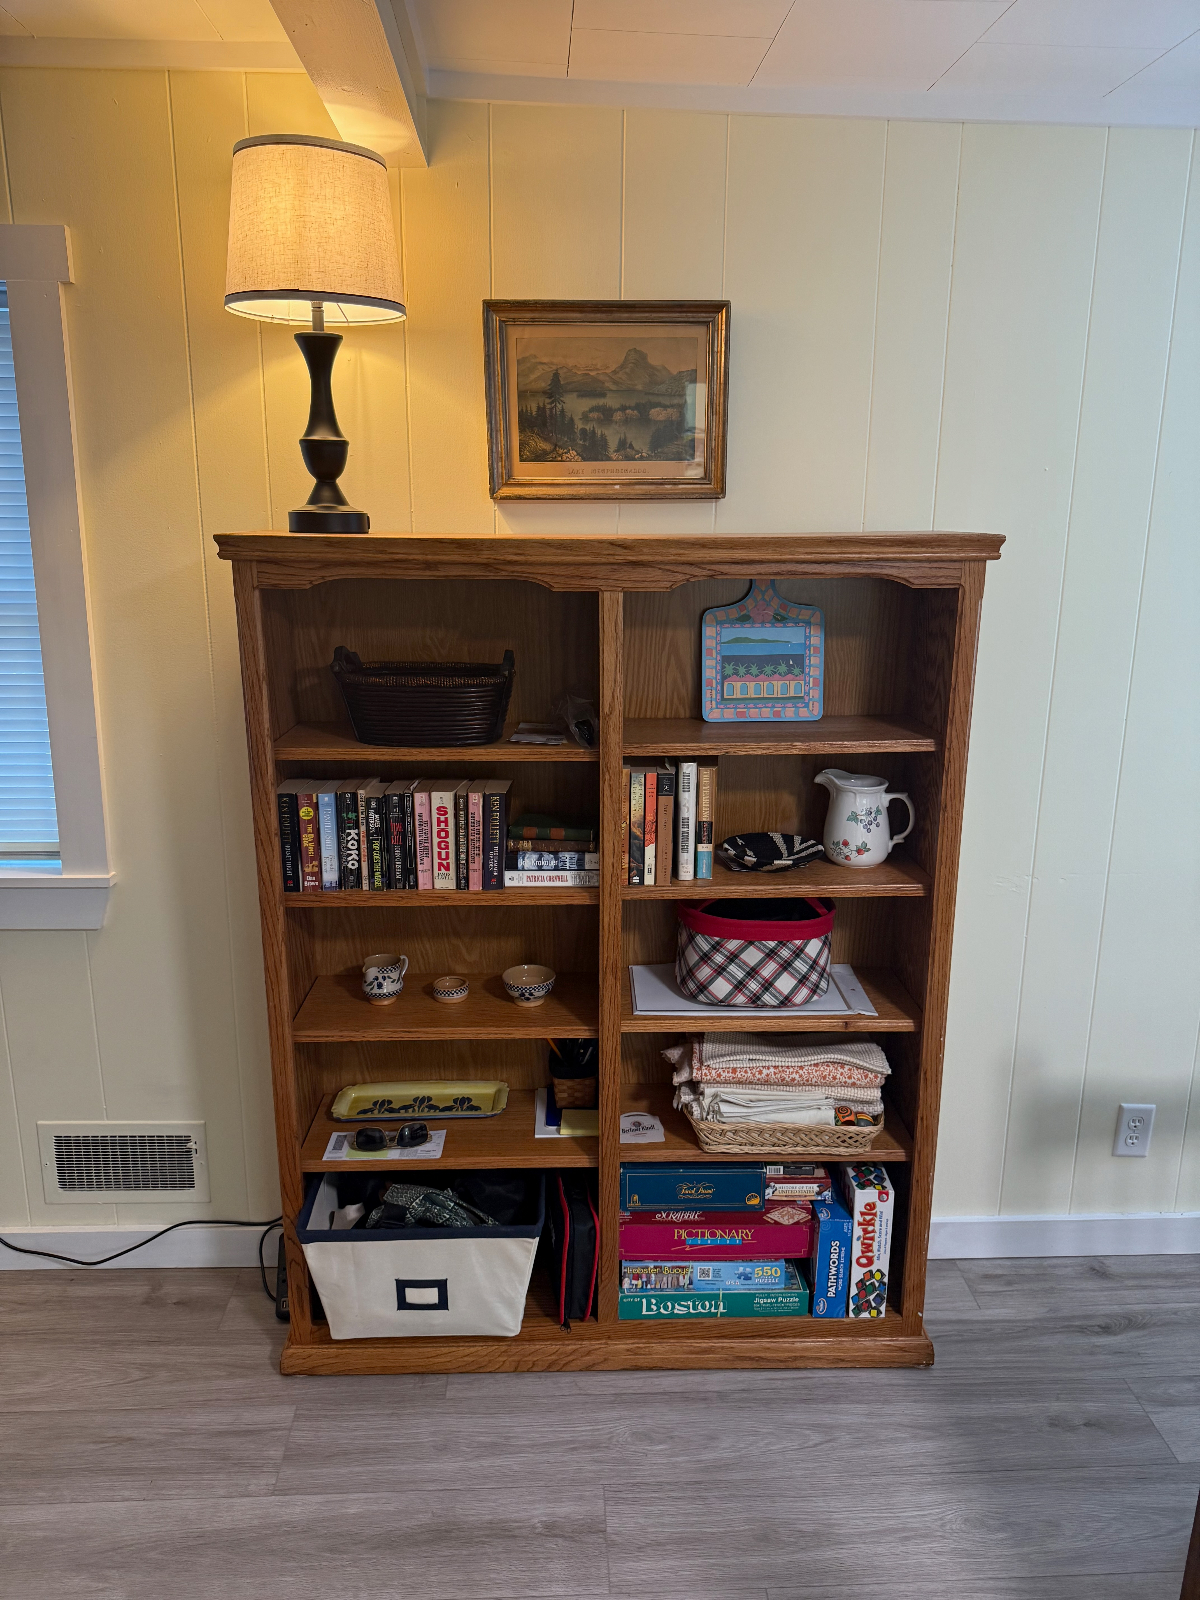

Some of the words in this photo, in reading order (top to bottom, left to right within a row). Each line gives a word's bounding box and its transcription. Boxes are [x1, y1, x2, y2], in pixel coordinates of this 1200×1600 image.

[490, 796, 500, 811] KEN
[702, 785, 711, 821] YEARLING
[489, 812, 500, 845] FOLLETT
[308, 833, 315, 842] DA
[345, 829, 360, 870] KOKO
[372, 840, 380, 850] POP
[373, 850, 381, 863] GOES
[655, 1210, 703, 1222] SCRABBLE
[674, 1228, 754, 1240] PICTIONARY
[855, 1201, 878, 1269] Qwirkle
[627, 1266, 660, 1275] Lobster
[662, 1266, 690, 1276] Buoys
[754, 1266, 781, 1278] 550
[827, 1240, 840, 1298] PATHWORDS
[642, 1297, 728, 1315] Boston
